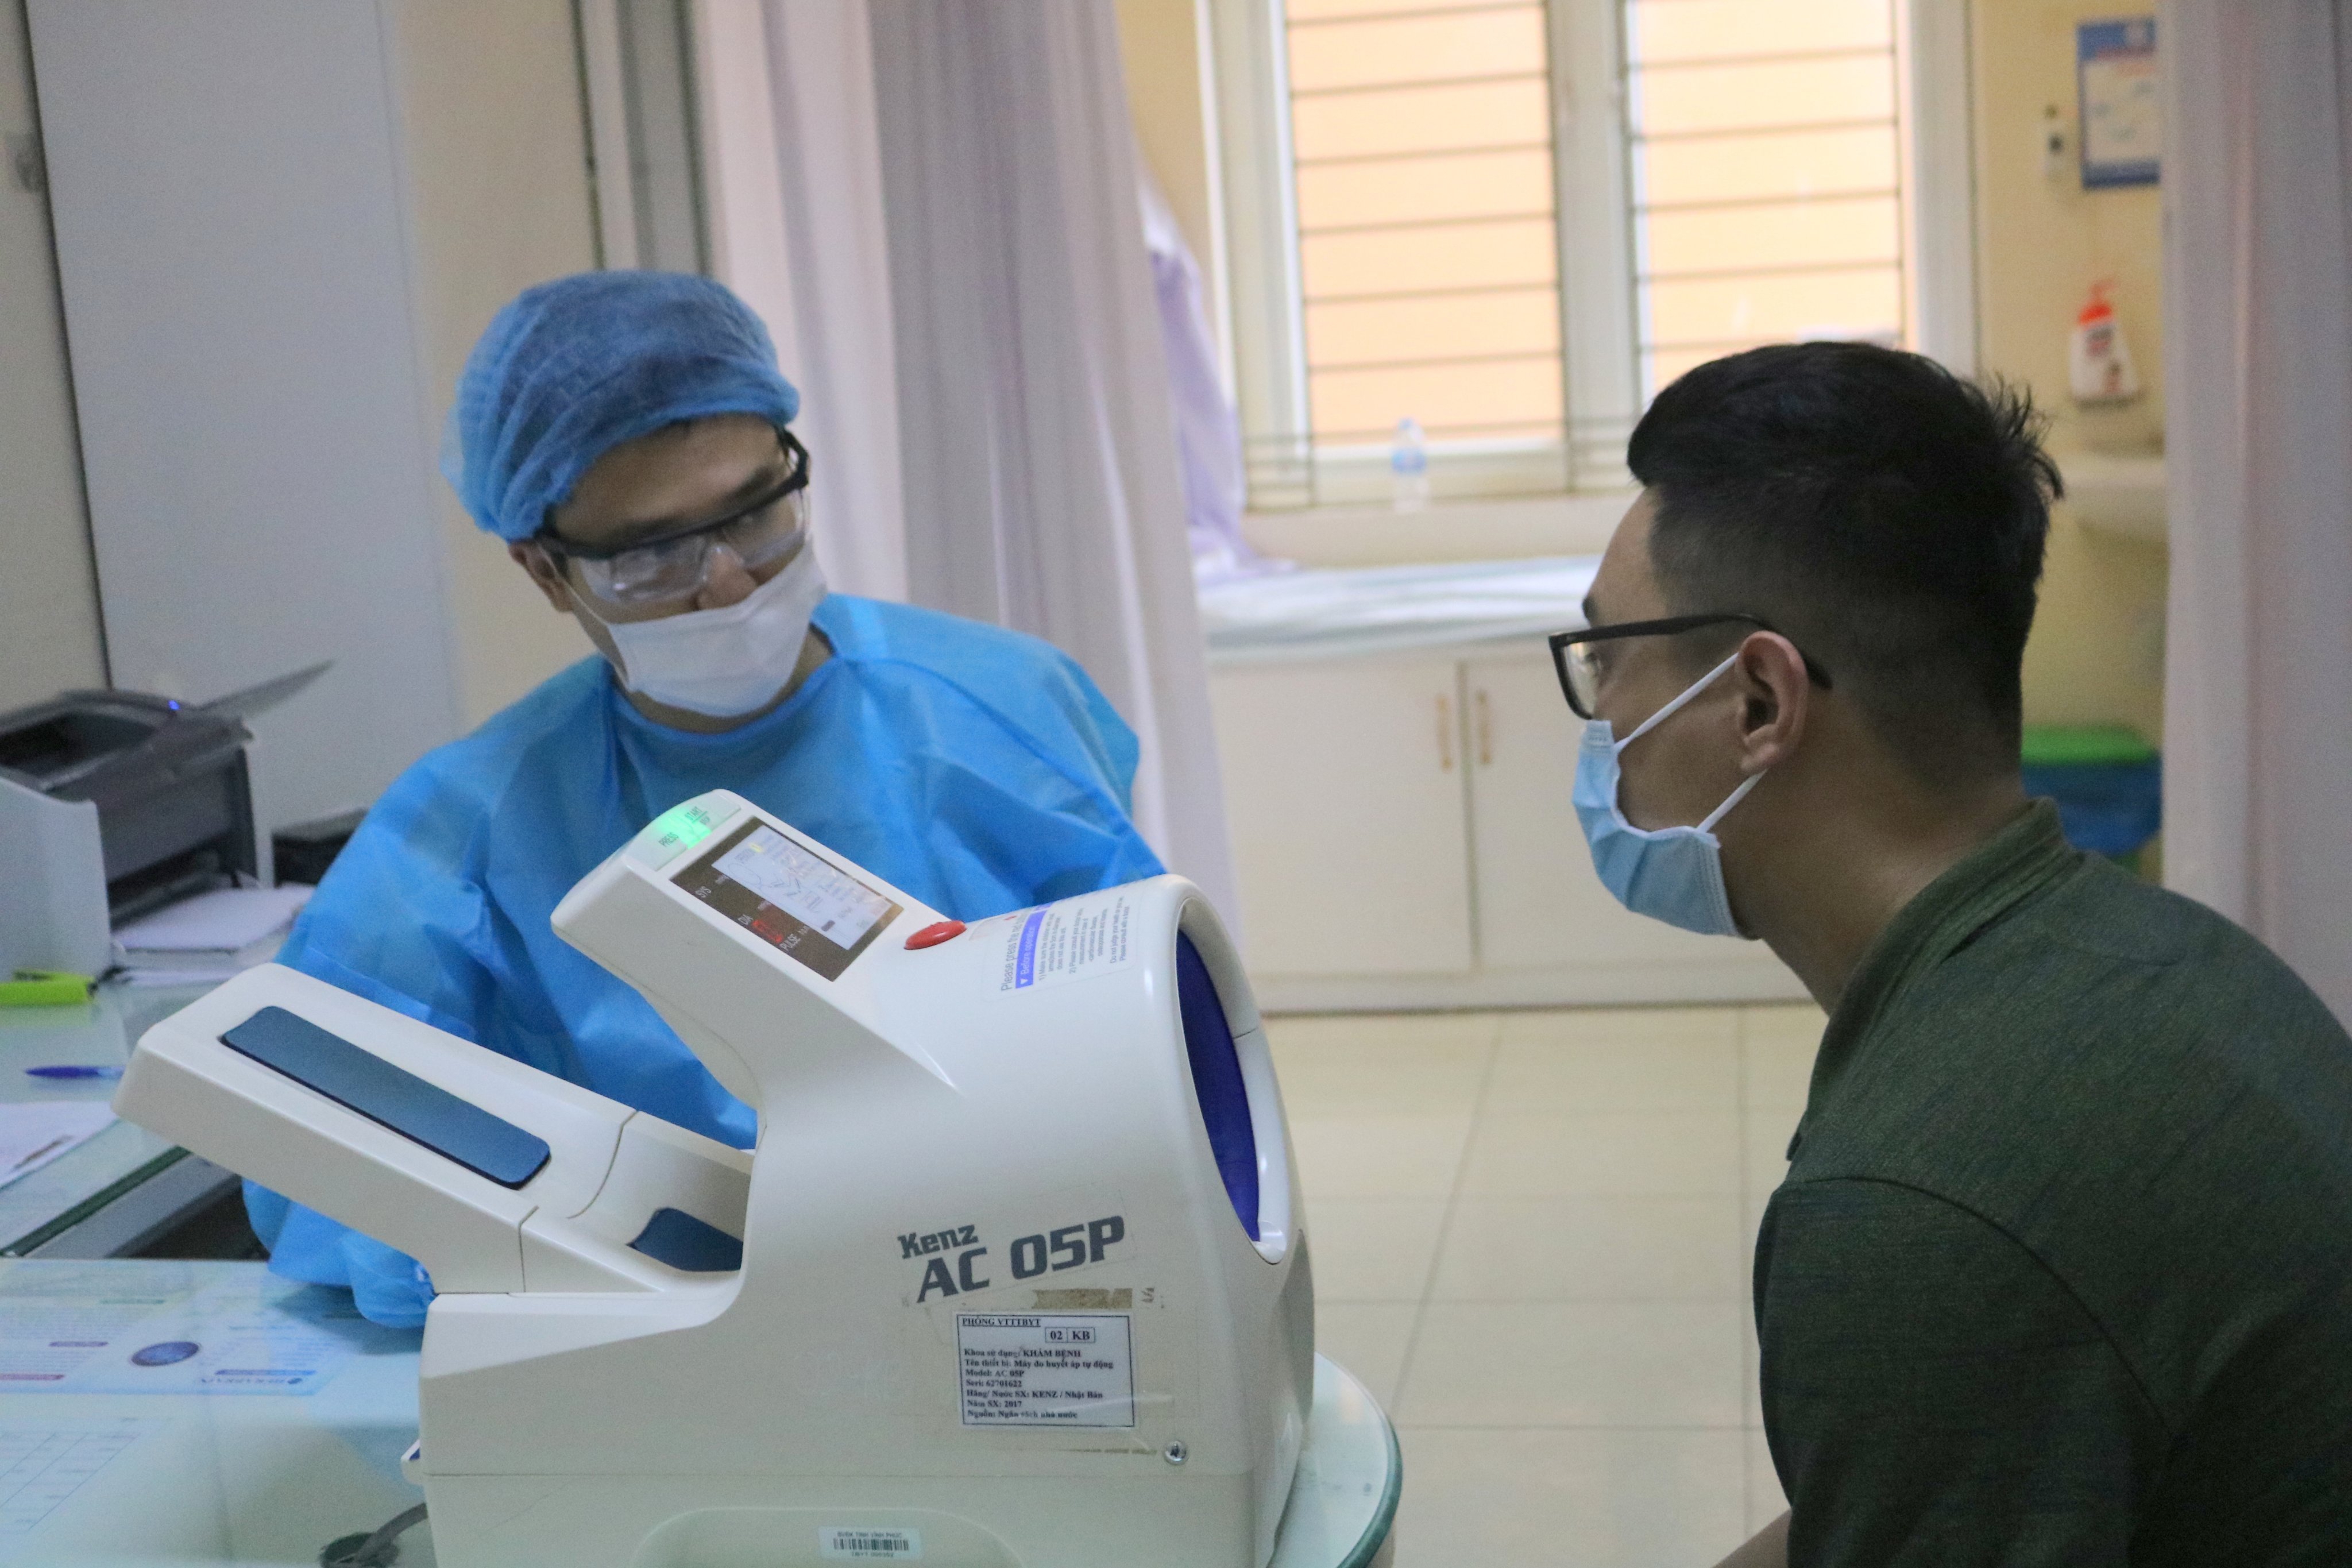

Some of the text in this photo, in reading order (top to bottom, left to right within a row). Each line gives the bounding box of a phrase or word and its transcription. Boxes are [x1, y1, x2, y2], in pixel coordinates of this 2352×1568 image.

[685, 806, 702, 820] START
[658, 832, 678, 847] PRESS
[696, 886, 712, 898] SYS
[738, 914, 752, 925] DIA
[780, 934, 801, 951] PULSE
[1007, 933, 1019, 942] the
[1006, 943, 1018, 961] press
[1021, 952, 1030, 974] Before
[1001, 963, 1013, 990] Please
[897, 1225, 979, 1259] Kenz
[917, 1215, 1125, 1303] AC 05P
[998, 1318, 1041, 1327] VTTTBYT
[1050, 1331, 1090, 1340] 02 KB
